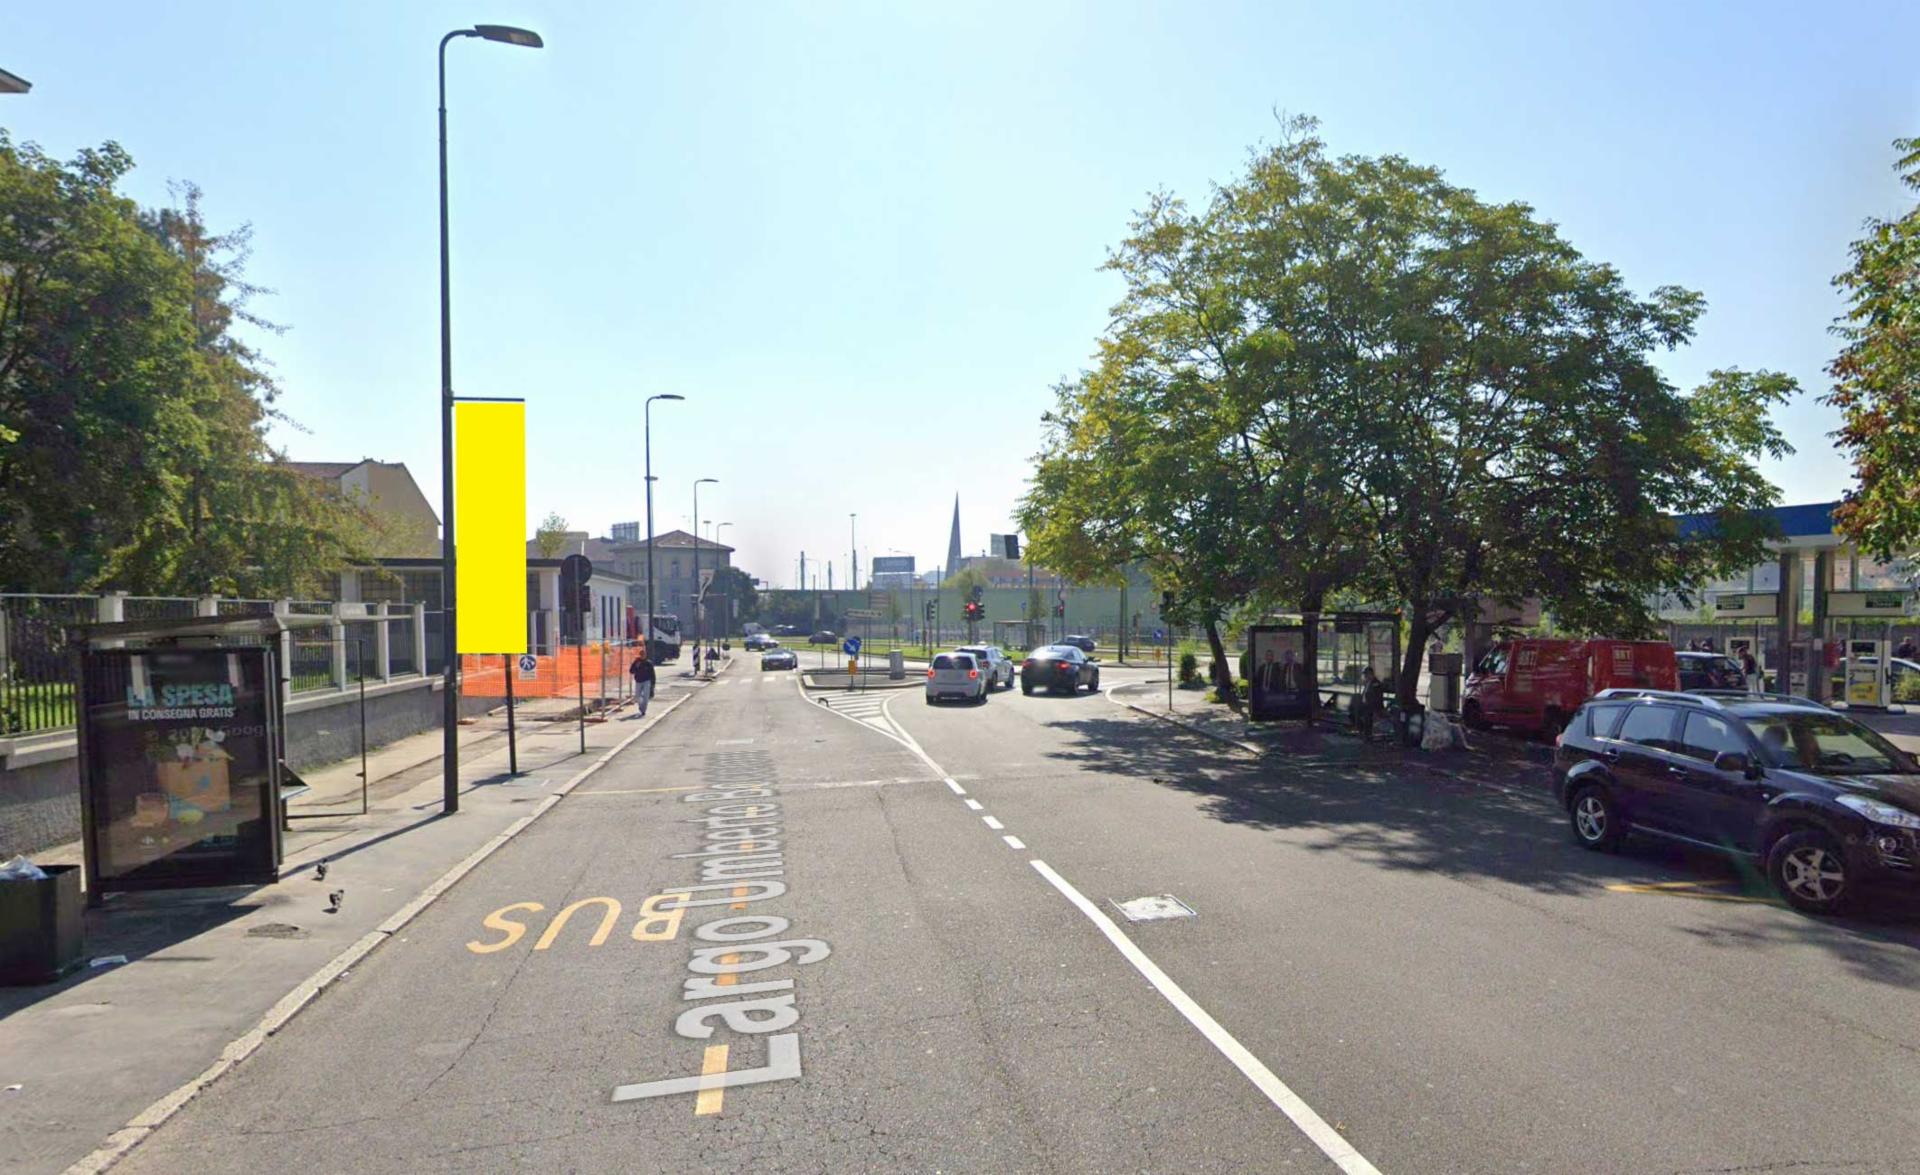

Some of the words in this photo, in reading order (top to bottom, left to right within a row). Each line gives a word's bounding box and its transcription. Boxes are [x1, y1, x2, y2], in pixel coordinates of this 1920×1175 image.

[127, 685, 157, 707] LA
[162, 683, 233, 707] SPESA
[128, 709, 139, 720] IN
[142, 708, 197, 720] CONSEGNA
[466, 892, 692, 954] BUS
